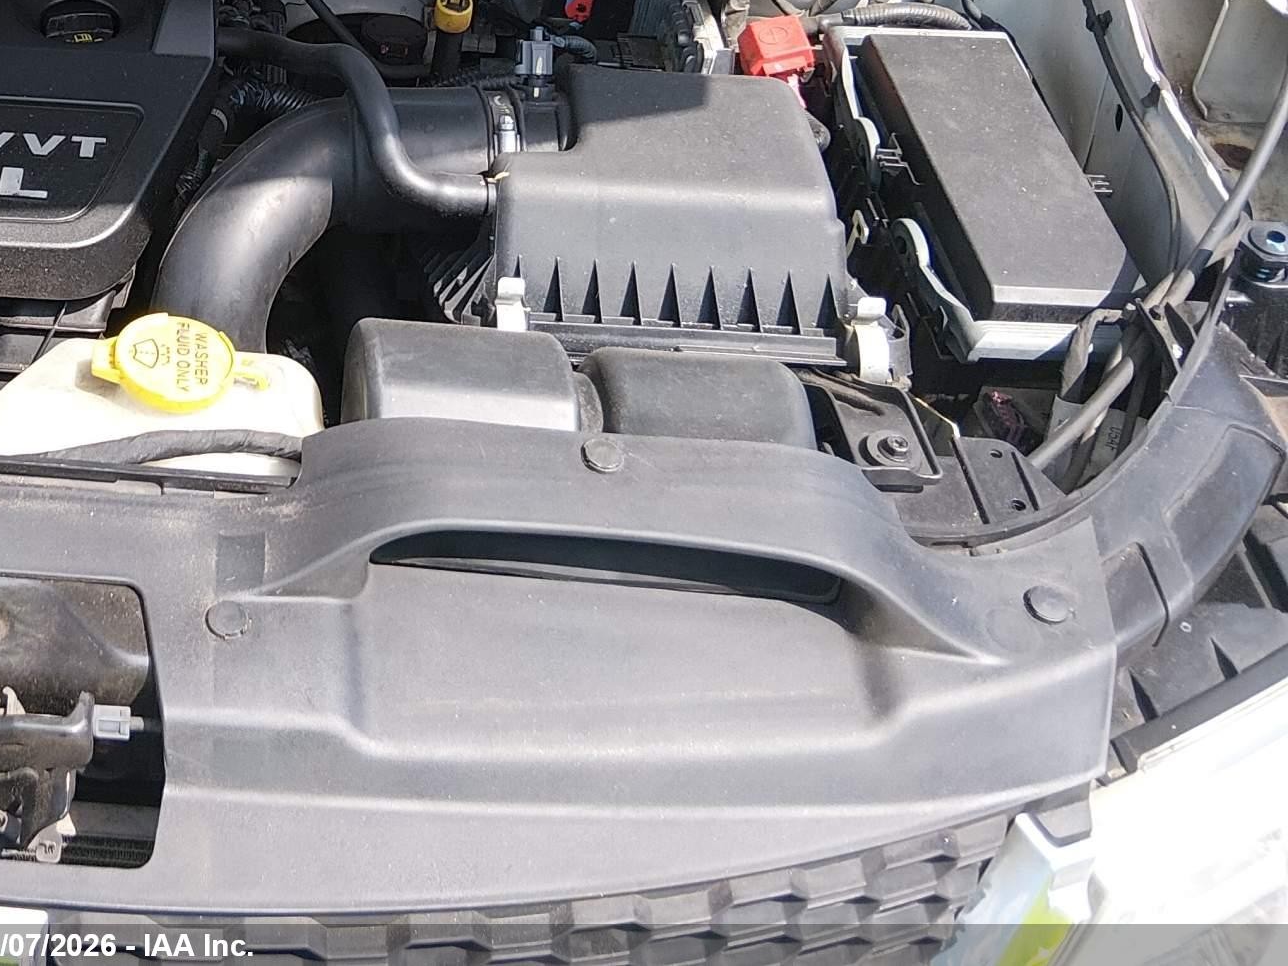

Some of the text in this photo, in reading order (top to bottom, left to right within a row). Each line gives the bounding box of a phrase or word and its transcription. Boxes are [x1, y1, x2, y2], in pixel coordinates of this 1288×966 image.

[176, 321, 191, 392] FLUID ONLY
[194, 332, 209, 386] WASHER
